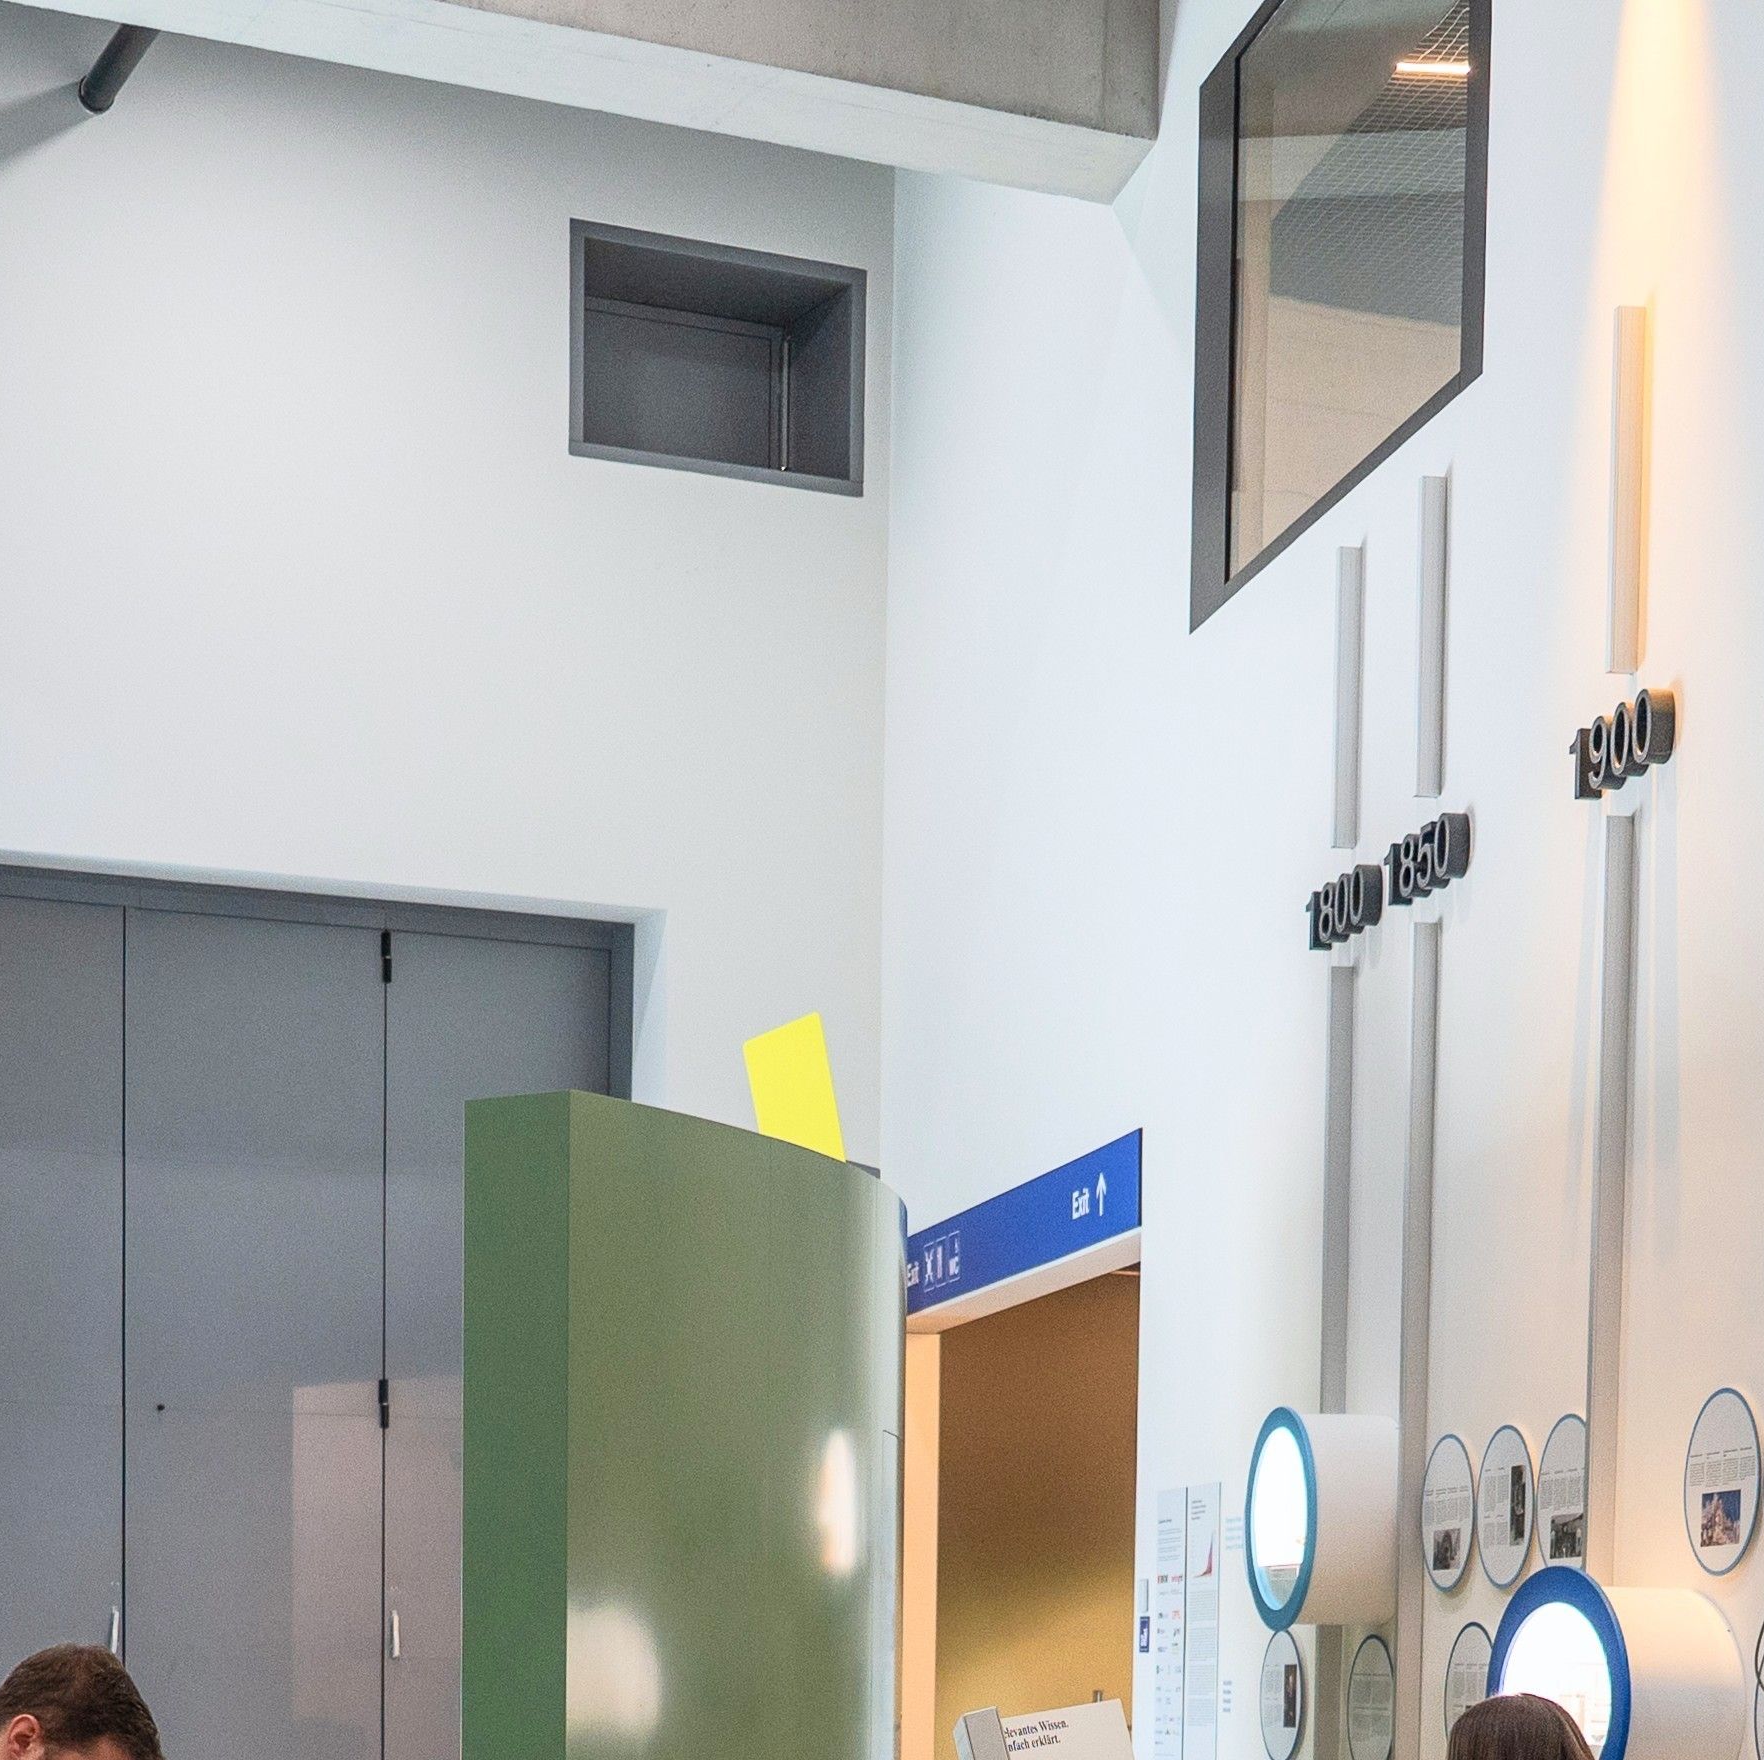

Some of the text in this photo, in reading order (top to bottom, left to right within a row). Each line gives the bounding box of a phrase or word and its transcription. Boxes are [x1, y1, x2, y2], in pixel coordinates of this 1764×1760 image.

[1570, 688, 1675, 800] 1900
[1384, 812, 1470, 906] 1850
[1306, 863, 1382, 951] 1800
[1072, 1187, 1090, 1220] Exit
